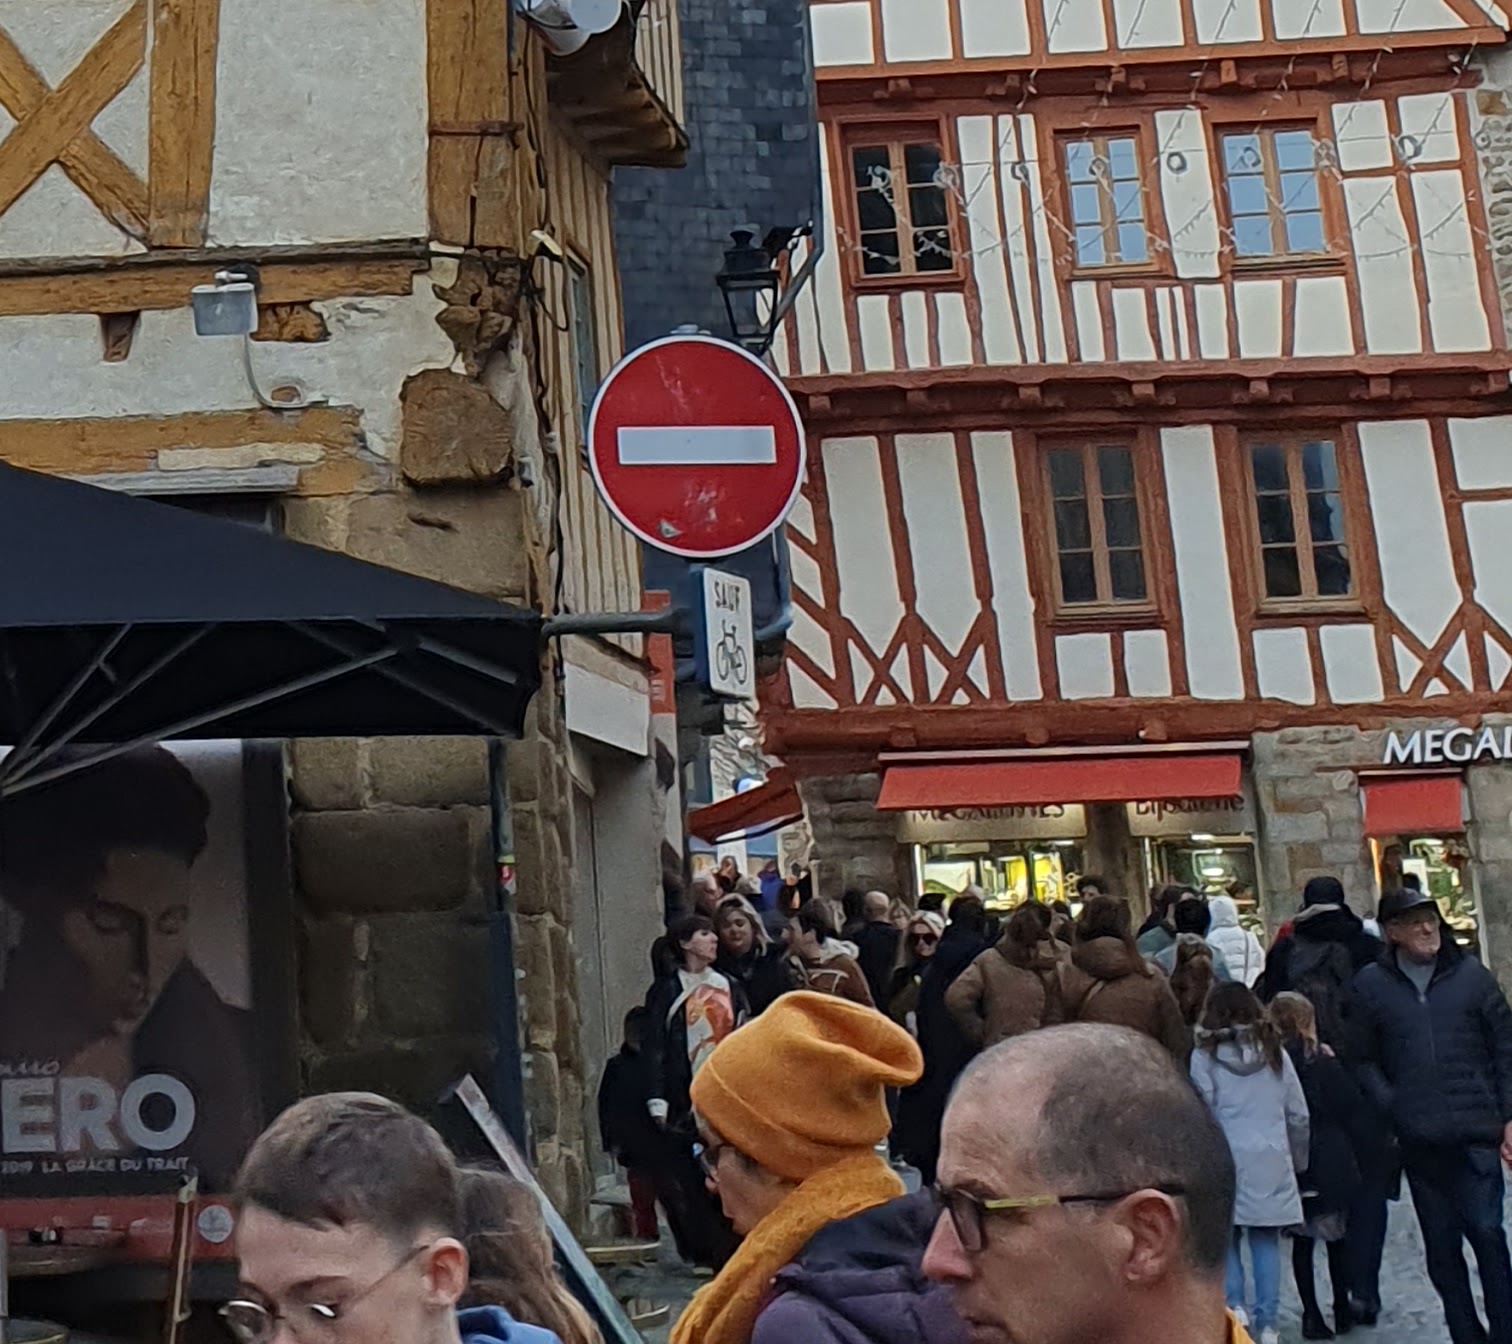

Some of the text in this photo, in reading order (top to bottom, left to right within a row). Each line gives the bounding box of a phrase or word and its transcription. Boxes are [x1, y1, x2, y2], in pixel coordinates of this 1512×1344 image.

[714, 580, 740, 613] SAUF
[42, 1160, 62, 1173] LA
[120, 1158, 142, 1172] DU
[147, 1156, 189, 1171] TRAIT
